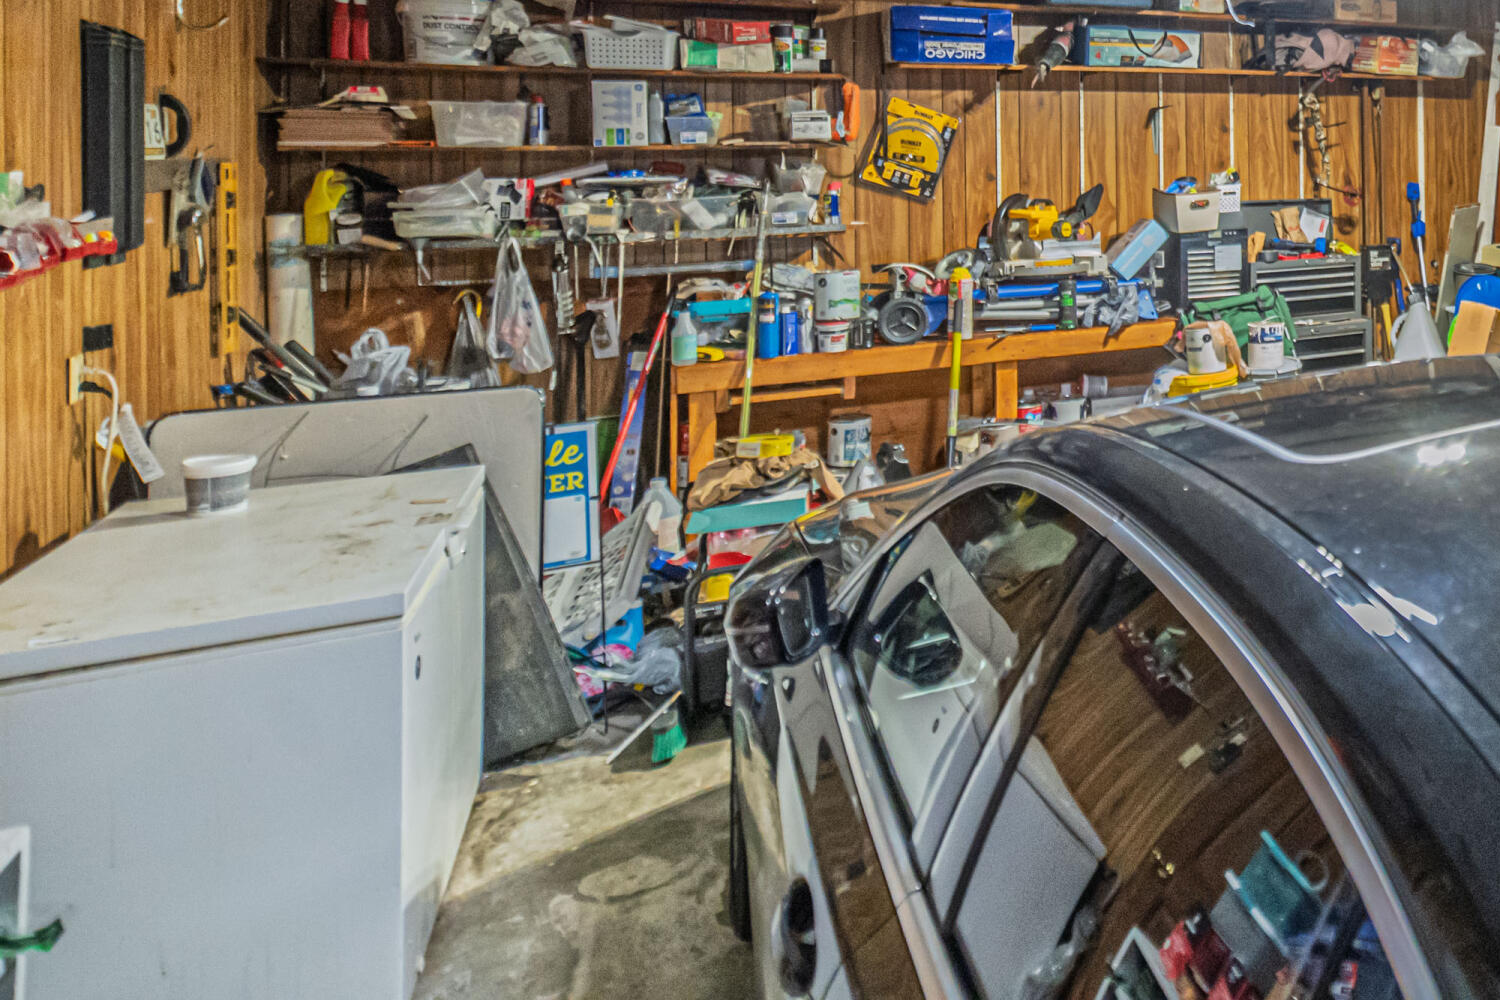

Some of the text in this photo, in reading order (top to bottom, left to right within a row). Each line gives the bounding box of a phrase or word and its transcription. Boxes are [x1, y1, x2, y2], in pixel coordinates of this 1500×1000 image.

[924, 48, 986, 60] CHICAGO
[545, 439, 585, 467] le
[546, 471, 585, 493] ER
